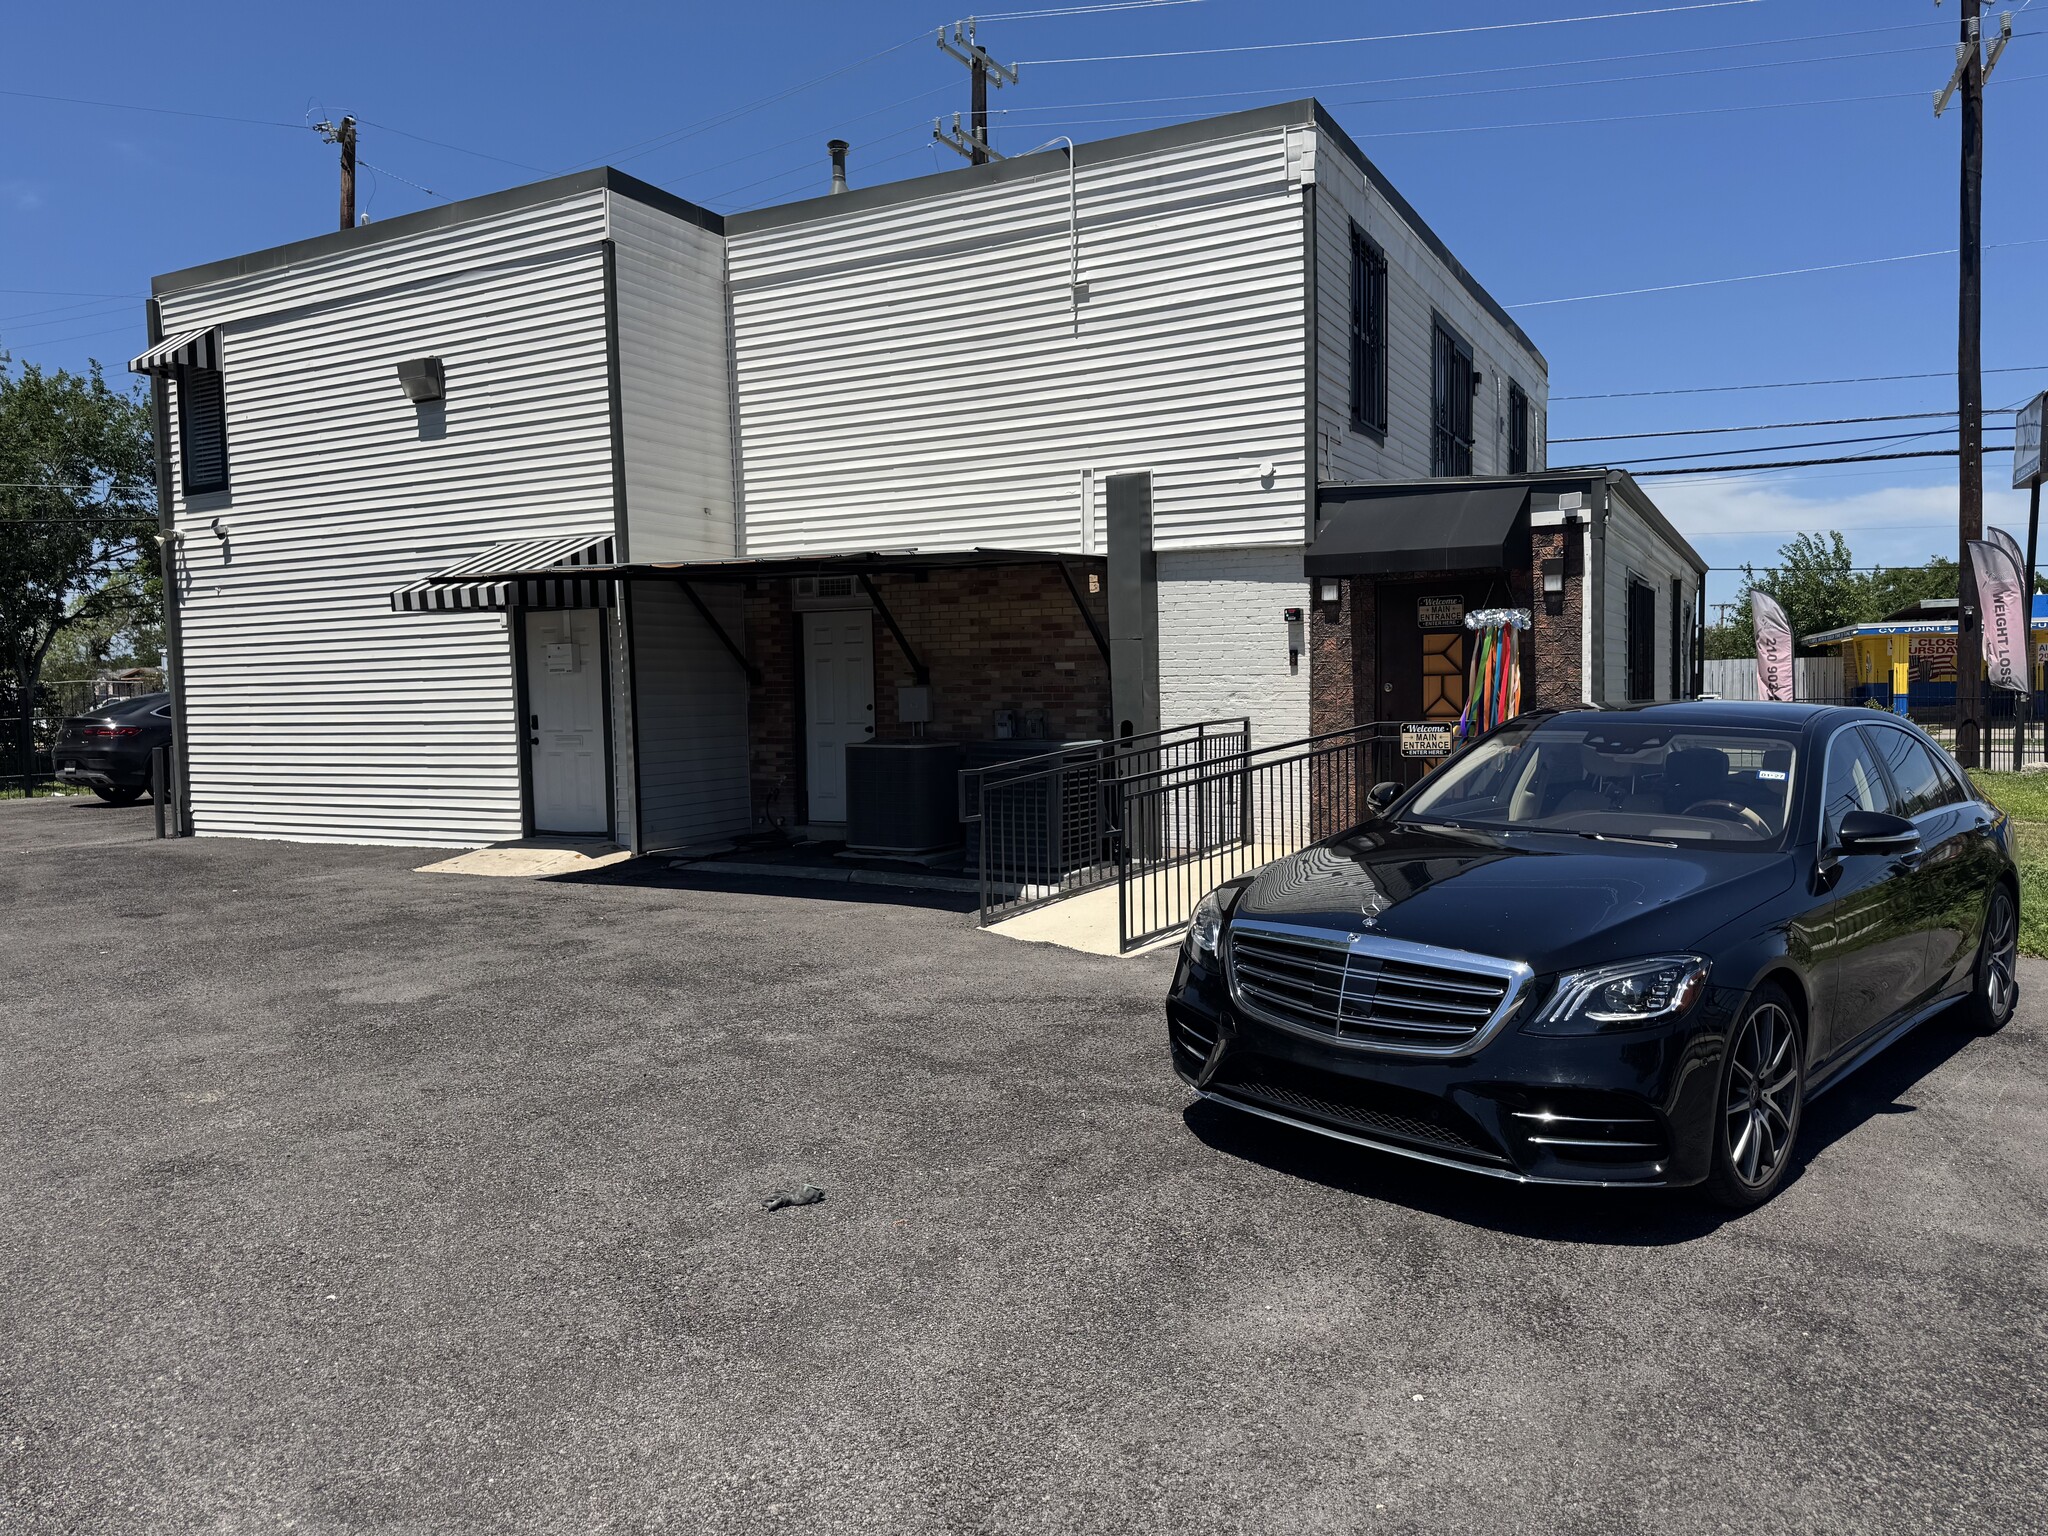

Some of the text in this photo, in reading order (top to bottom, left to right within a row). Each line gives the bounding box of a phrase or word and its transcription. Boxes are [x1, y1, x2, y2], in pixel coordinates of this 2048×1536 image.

[1420, 612, 1461, 621] ENTRANCE
[1992, 592, 2008, 645] WEIGHT
[1918, 638, 1958, 646] CLOS
[1766, 638, 1778, 662] 210
[1999, 650, 2012, 685] LOSS
[1406, 724, 1445, 733] Welcome
[1415, 733, 1437, 741] MAIN
[1403, 741, 1450, 749] ENTRANCE
